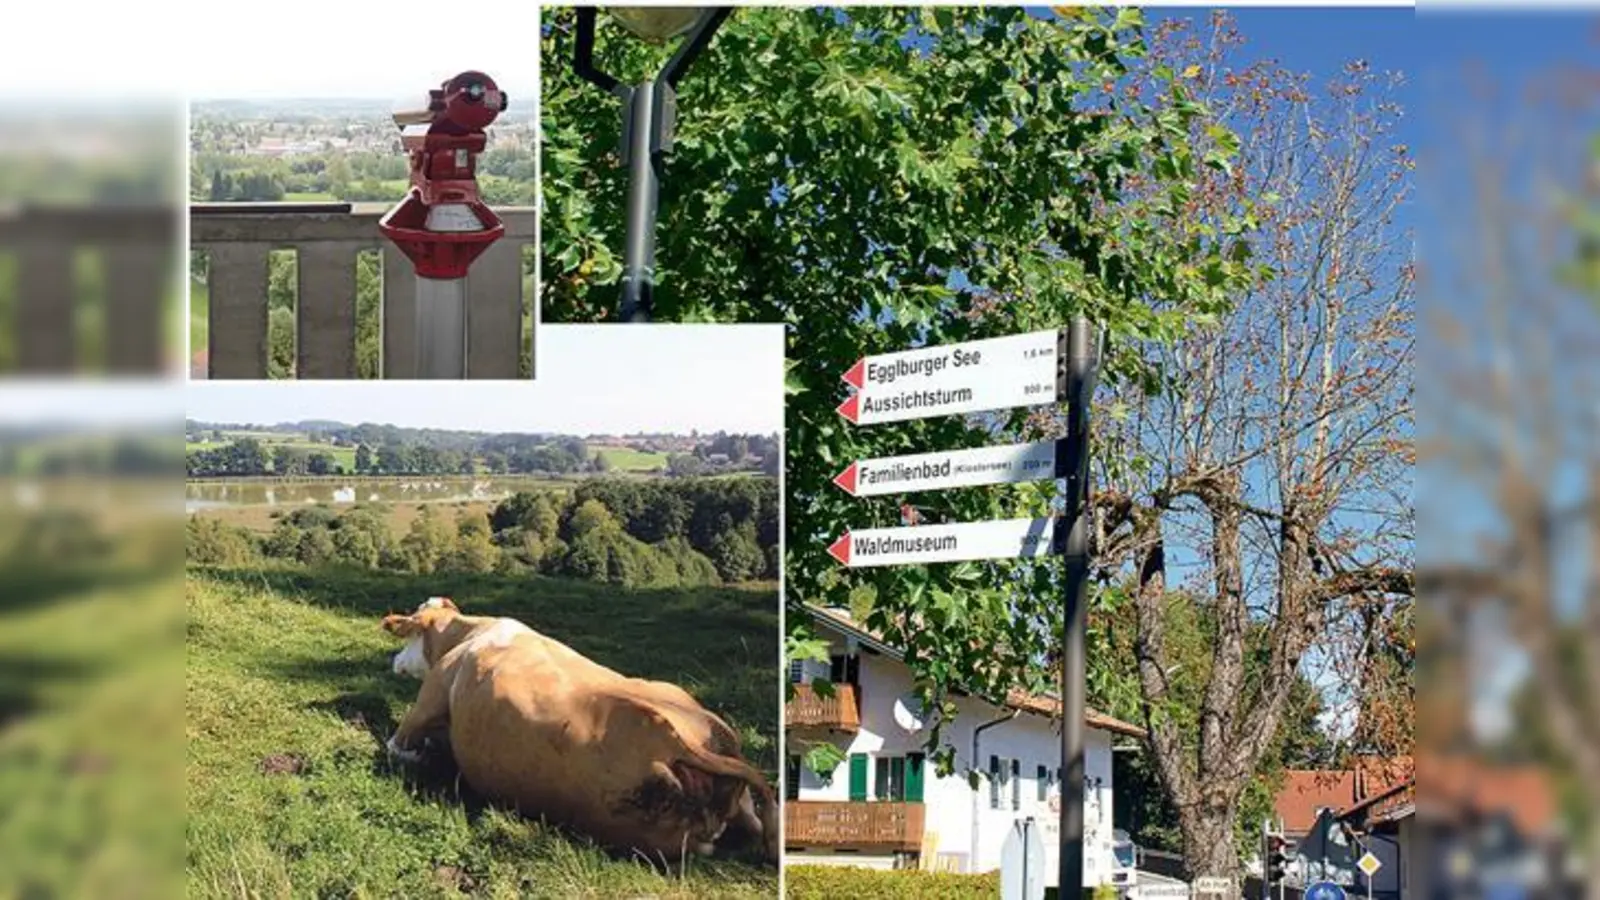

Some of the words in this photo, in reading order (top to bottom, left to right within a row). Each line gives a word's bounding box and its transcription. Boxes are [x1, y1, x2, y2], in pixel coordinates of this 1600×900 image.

[867, 354, 948, 384] Egglburger
[953, 348, 981, 366] See
[862, 387, 972, 414] Aussichtsturm
[859, 460, 951, 485] Familienbad
[854, 534, 957, 556] Waldmuseum
